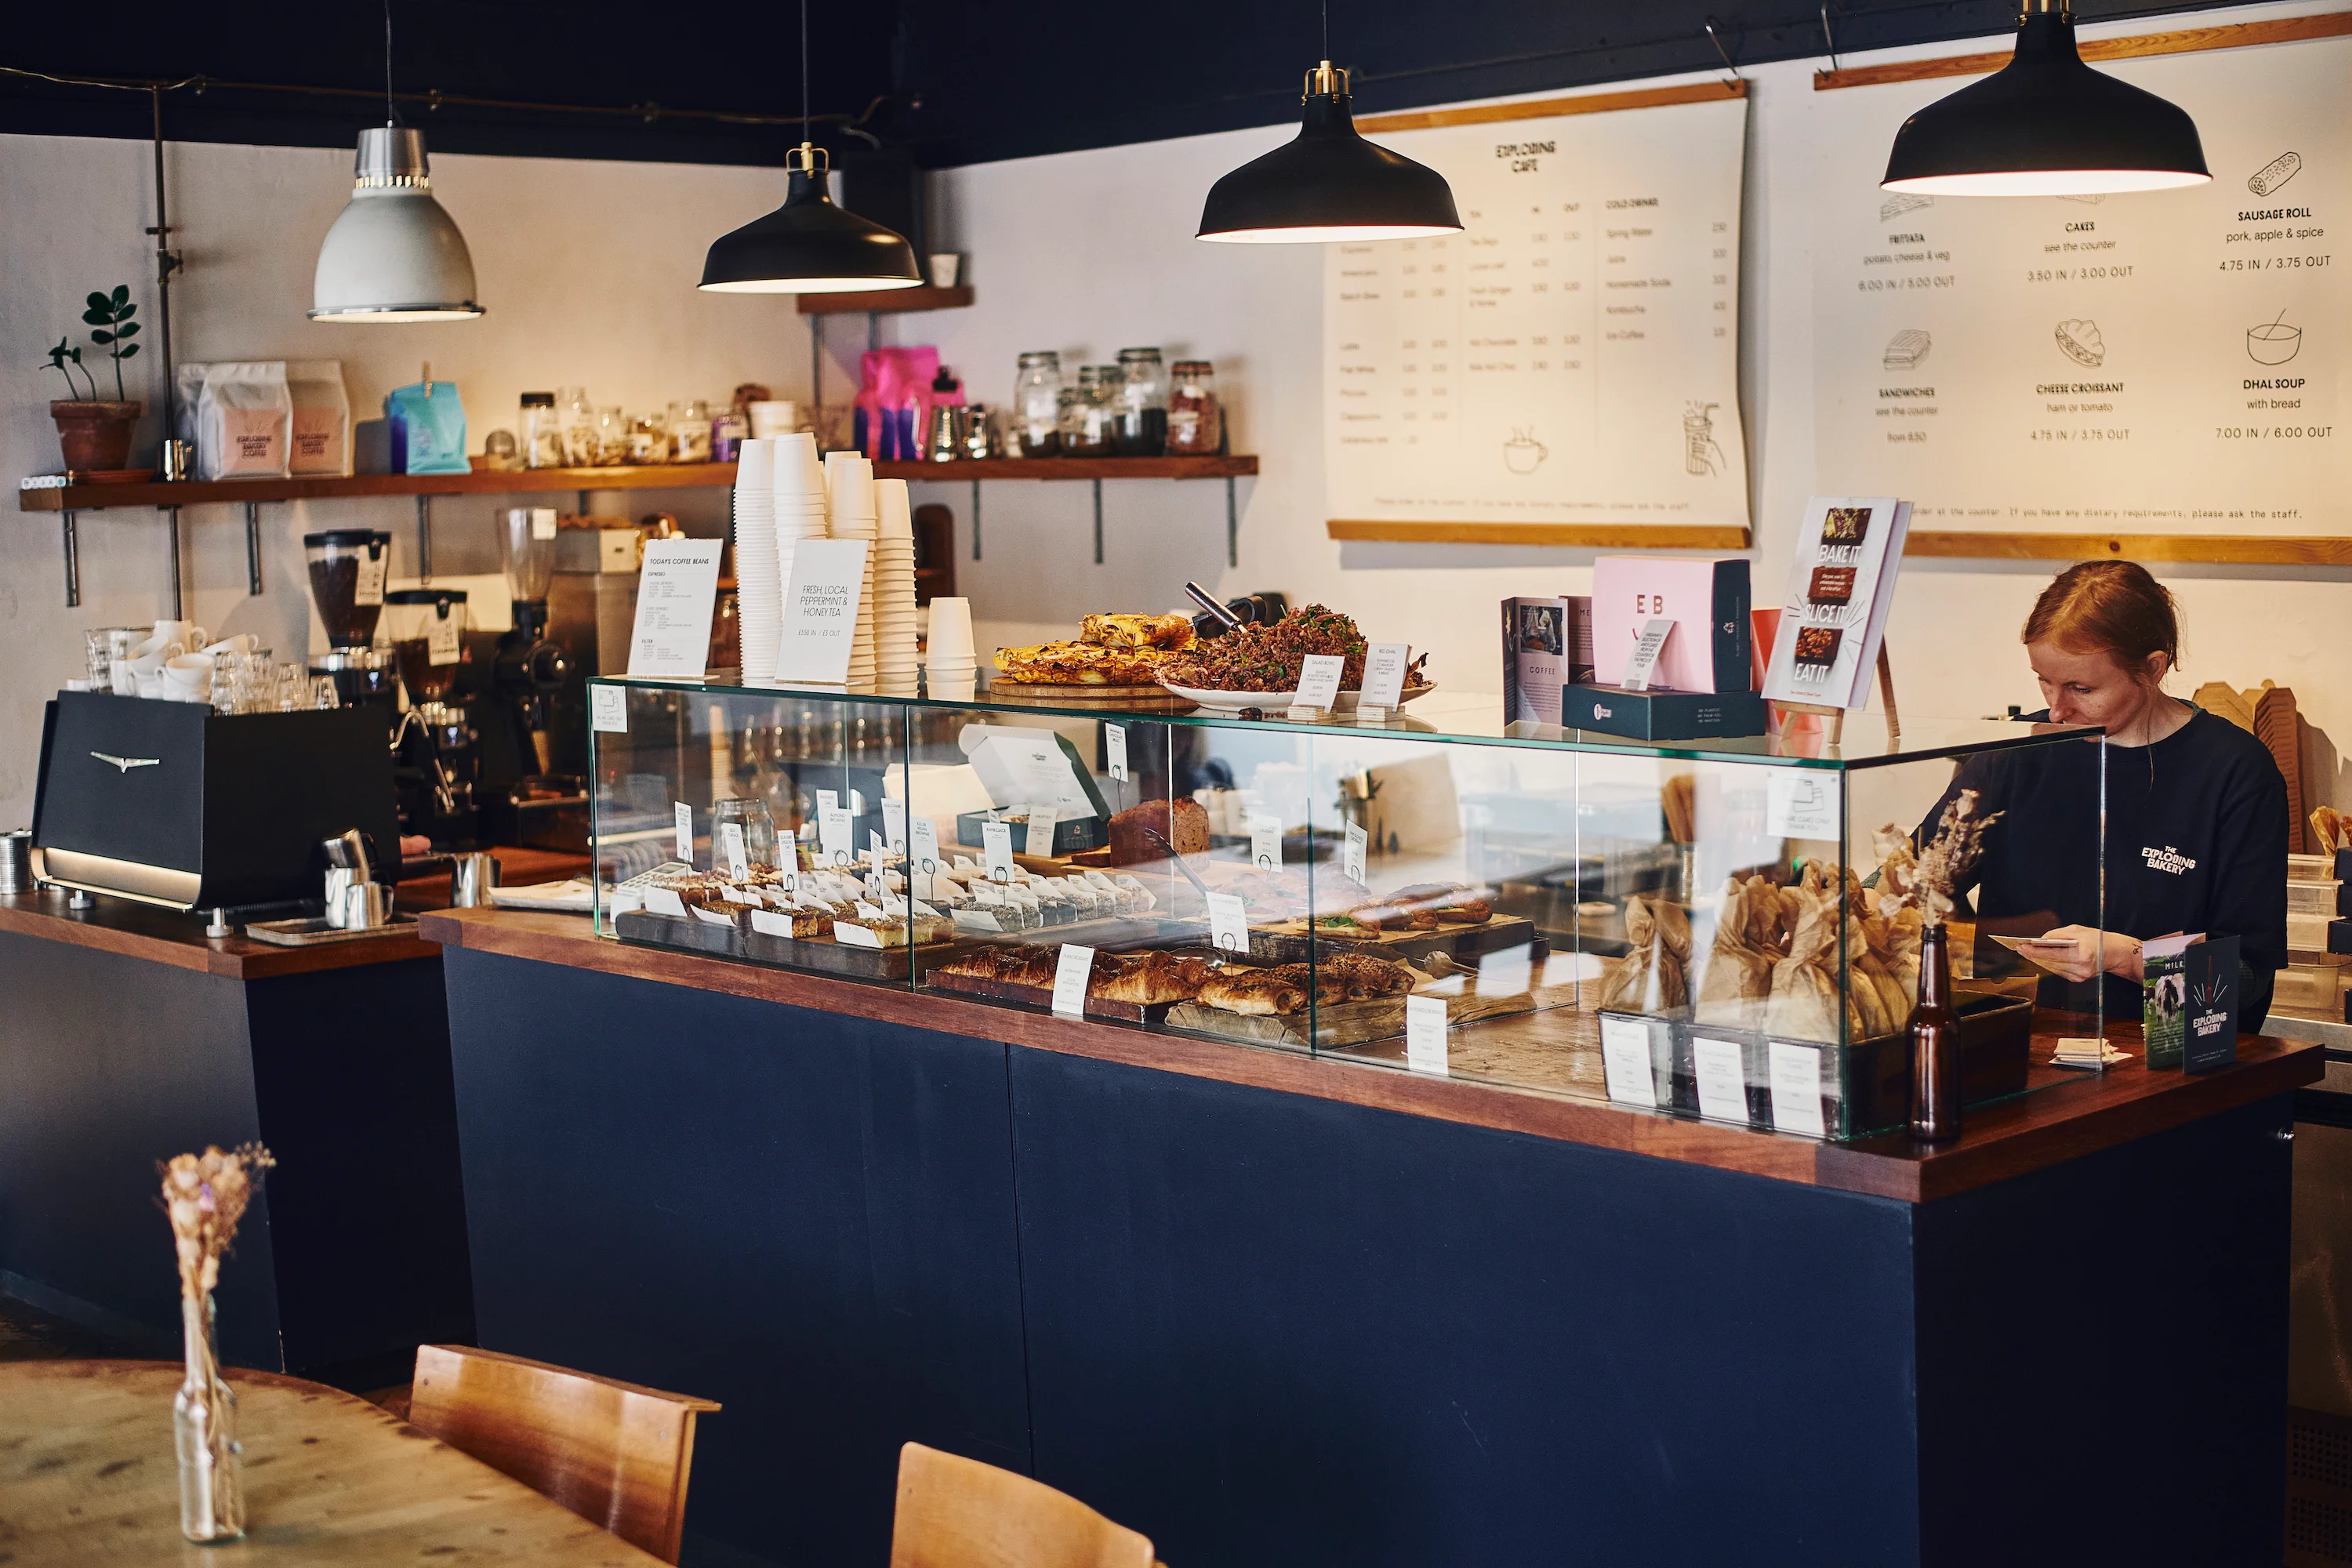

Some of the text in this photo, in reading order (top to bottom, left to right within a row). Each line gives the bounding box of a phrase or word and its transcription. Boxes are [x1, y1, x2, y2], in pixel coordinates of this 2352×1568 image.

[2238, 208, 2312, 221] SAUSAGE ROLL
[2065, 221, 2096, 233] CAKES
[2227, 227, 2325, 244] pork, apple & spice
[2044, 240, 2117, 253] see the counter
[2220, 256, 2331, 271] 4.75 IN / 3.75 OUT
[2056, 269, 2067, 281] IN
[2071, 268, 2077, 281] /
[2081, 267, 2107, 280] 3.00
[2111, 266, 2134, 278] OUT
[1933, 275, 1955, 289] OUT
[2036, 382, 2125, 395] CHEESE CROISSANT
[2243, 378, 2306, 390] DHAL SOUP
[1878, 387, 1936, 399] SANDWICHES
[2046, 402, 2114, 413] ham or tomato
[2247, 397, 2301, 410] with bread
[1907, 405, 1939, 417] counter
[2056, 429, 2067, 441] IN
[2107, 428, 2130, 441] OUT
[2216, 426, 2332, 439] 7.00 IN / 6.00 OUT
[2023, 508, 2038, 518] you
[2041, 506, 2061, 517] have
[2064, 509, 2080, 518] any
[2083, 507, 2118, 518] dietary
[2122, 508, 2187, 518] requirements,
[2191, 509, 2223, 519] please
[2228, 509, 2244, 518] ask
[2250, 510, 2266, 518] the
[2271, 509, 2303, 519] staff.
[1818, 544, 1862, 564] BAKE IT
[803, 585, 848, 595] FRESH, LOCAL
[800, 596, 848, 605] PEPPERMINT &
[804, 608, 840, 617] HONEY TEA
[1803, 604, 1848, 625] SLICE IT
[1529, 666, 1555, 675] COFFEE
[1794, 663, 1829, 684] EAT IT
[2141, 847, 2197, 869] EXPLODING
[2147, 858, 2186, 875] BAKERY
[2165, 961, 2184, 970] MILK
[2193, 1012, 2227, 1029] EXPLODING
[2198, 1022, 2222, 1036] BAKERY
